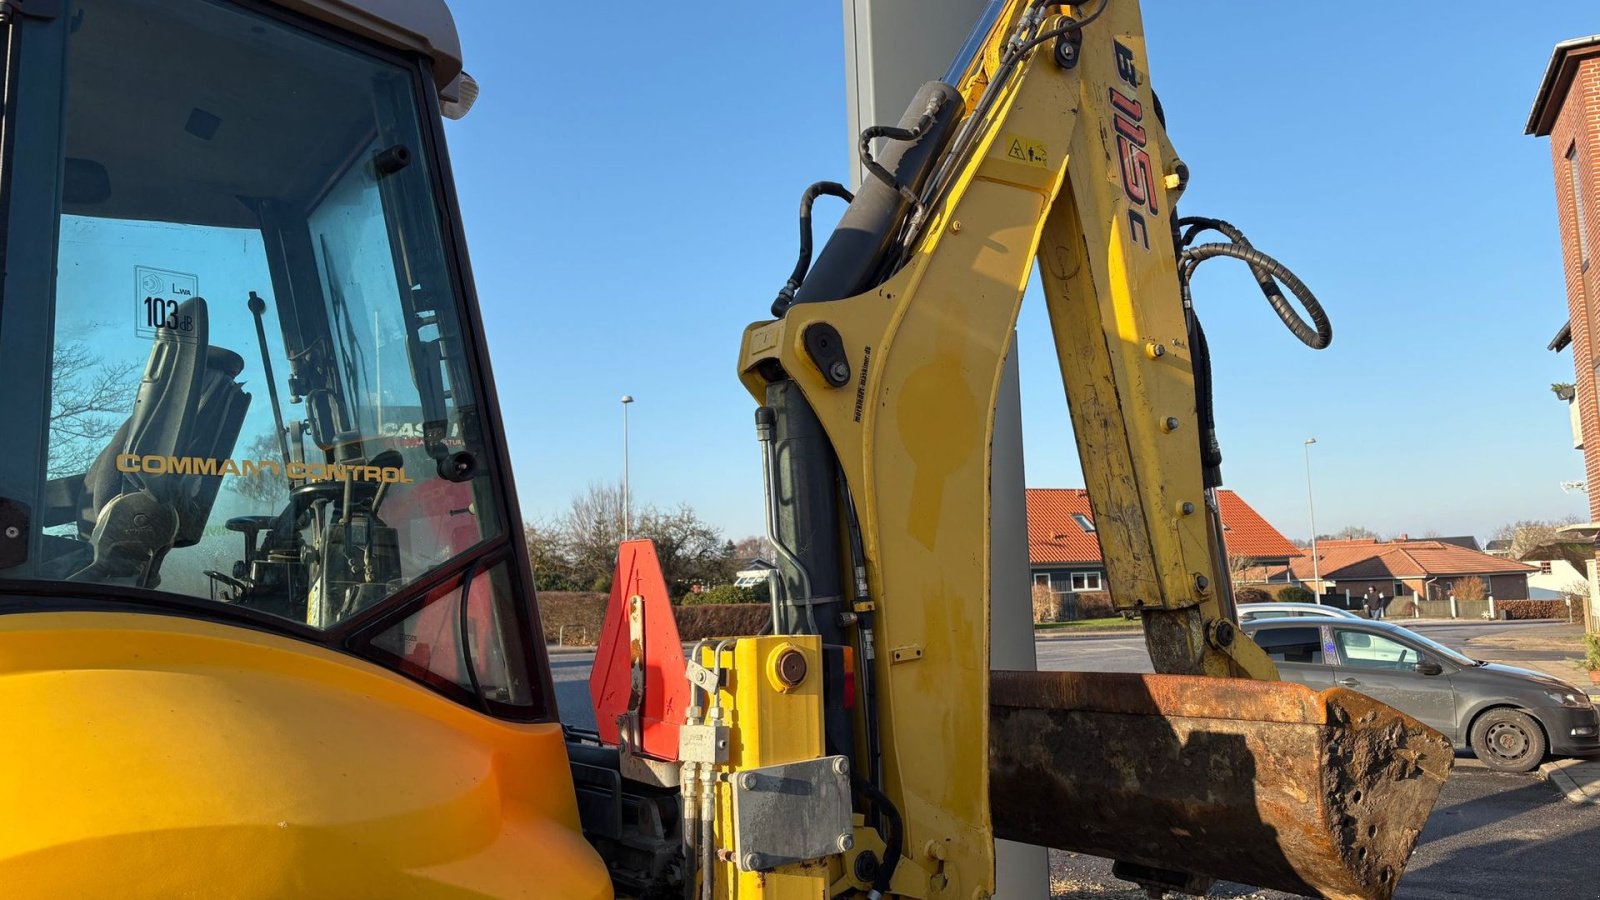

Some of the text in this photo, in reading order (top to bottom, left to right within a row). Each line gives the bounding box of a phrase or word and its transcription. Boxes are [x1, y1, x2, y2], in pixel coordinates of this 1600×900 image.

[144, 296, 194, 332] 103 dB
[383, 422, 425, 438] CAS
[287, 461, 414, 484] CONTROL
